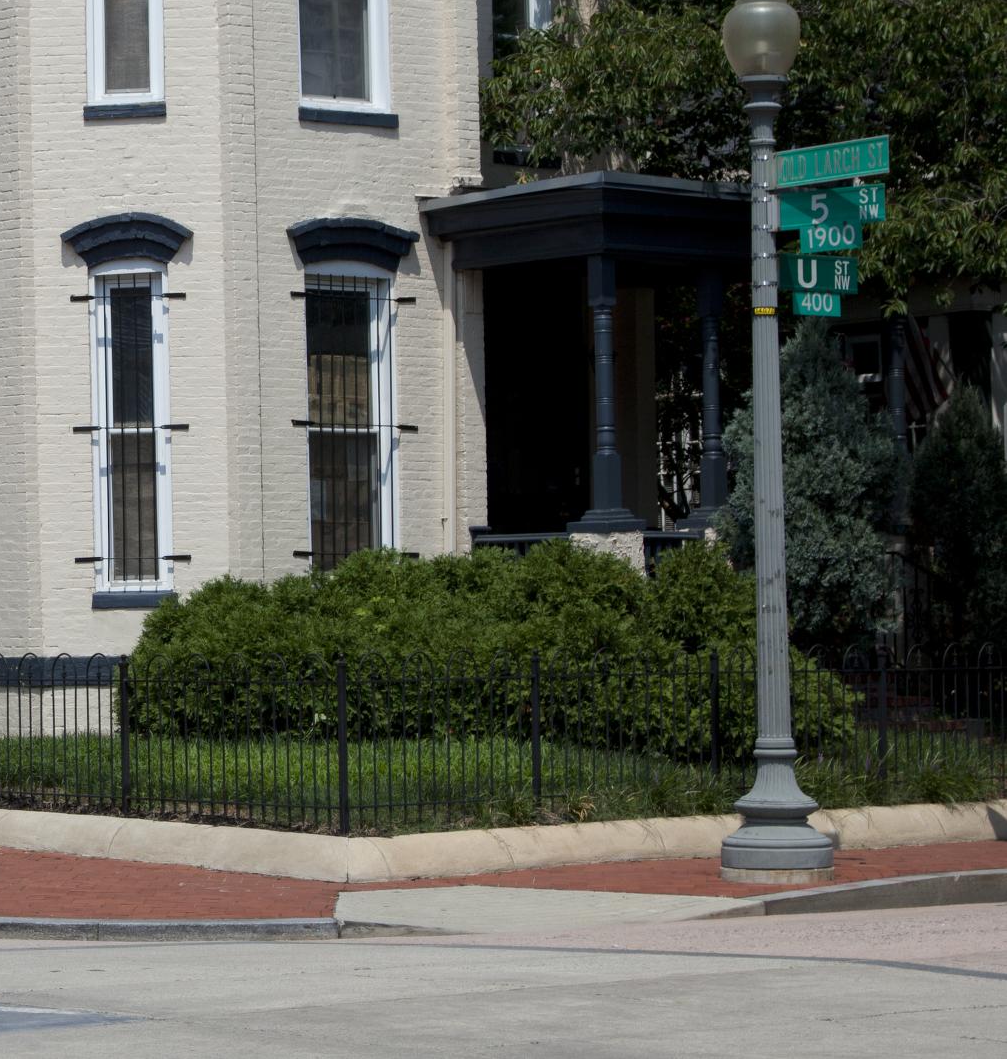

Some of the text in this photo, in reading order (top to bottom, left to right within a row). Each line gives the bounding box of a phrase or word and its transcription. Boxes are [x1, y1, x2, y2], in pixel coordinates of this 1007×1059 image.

[814, 146, 861, 177] LARCH
[859, 187, 878, 204] ST
[811, 193, 829, 224] 5
[859, 204, 879, 220] NW
[807, 224, 855, 249] 1900
[797, 259, 818, 289] U
[834, 260, 850, 275] ST
[834, 275, 851, 290] NW
[801, 292, 833, 312] 400
